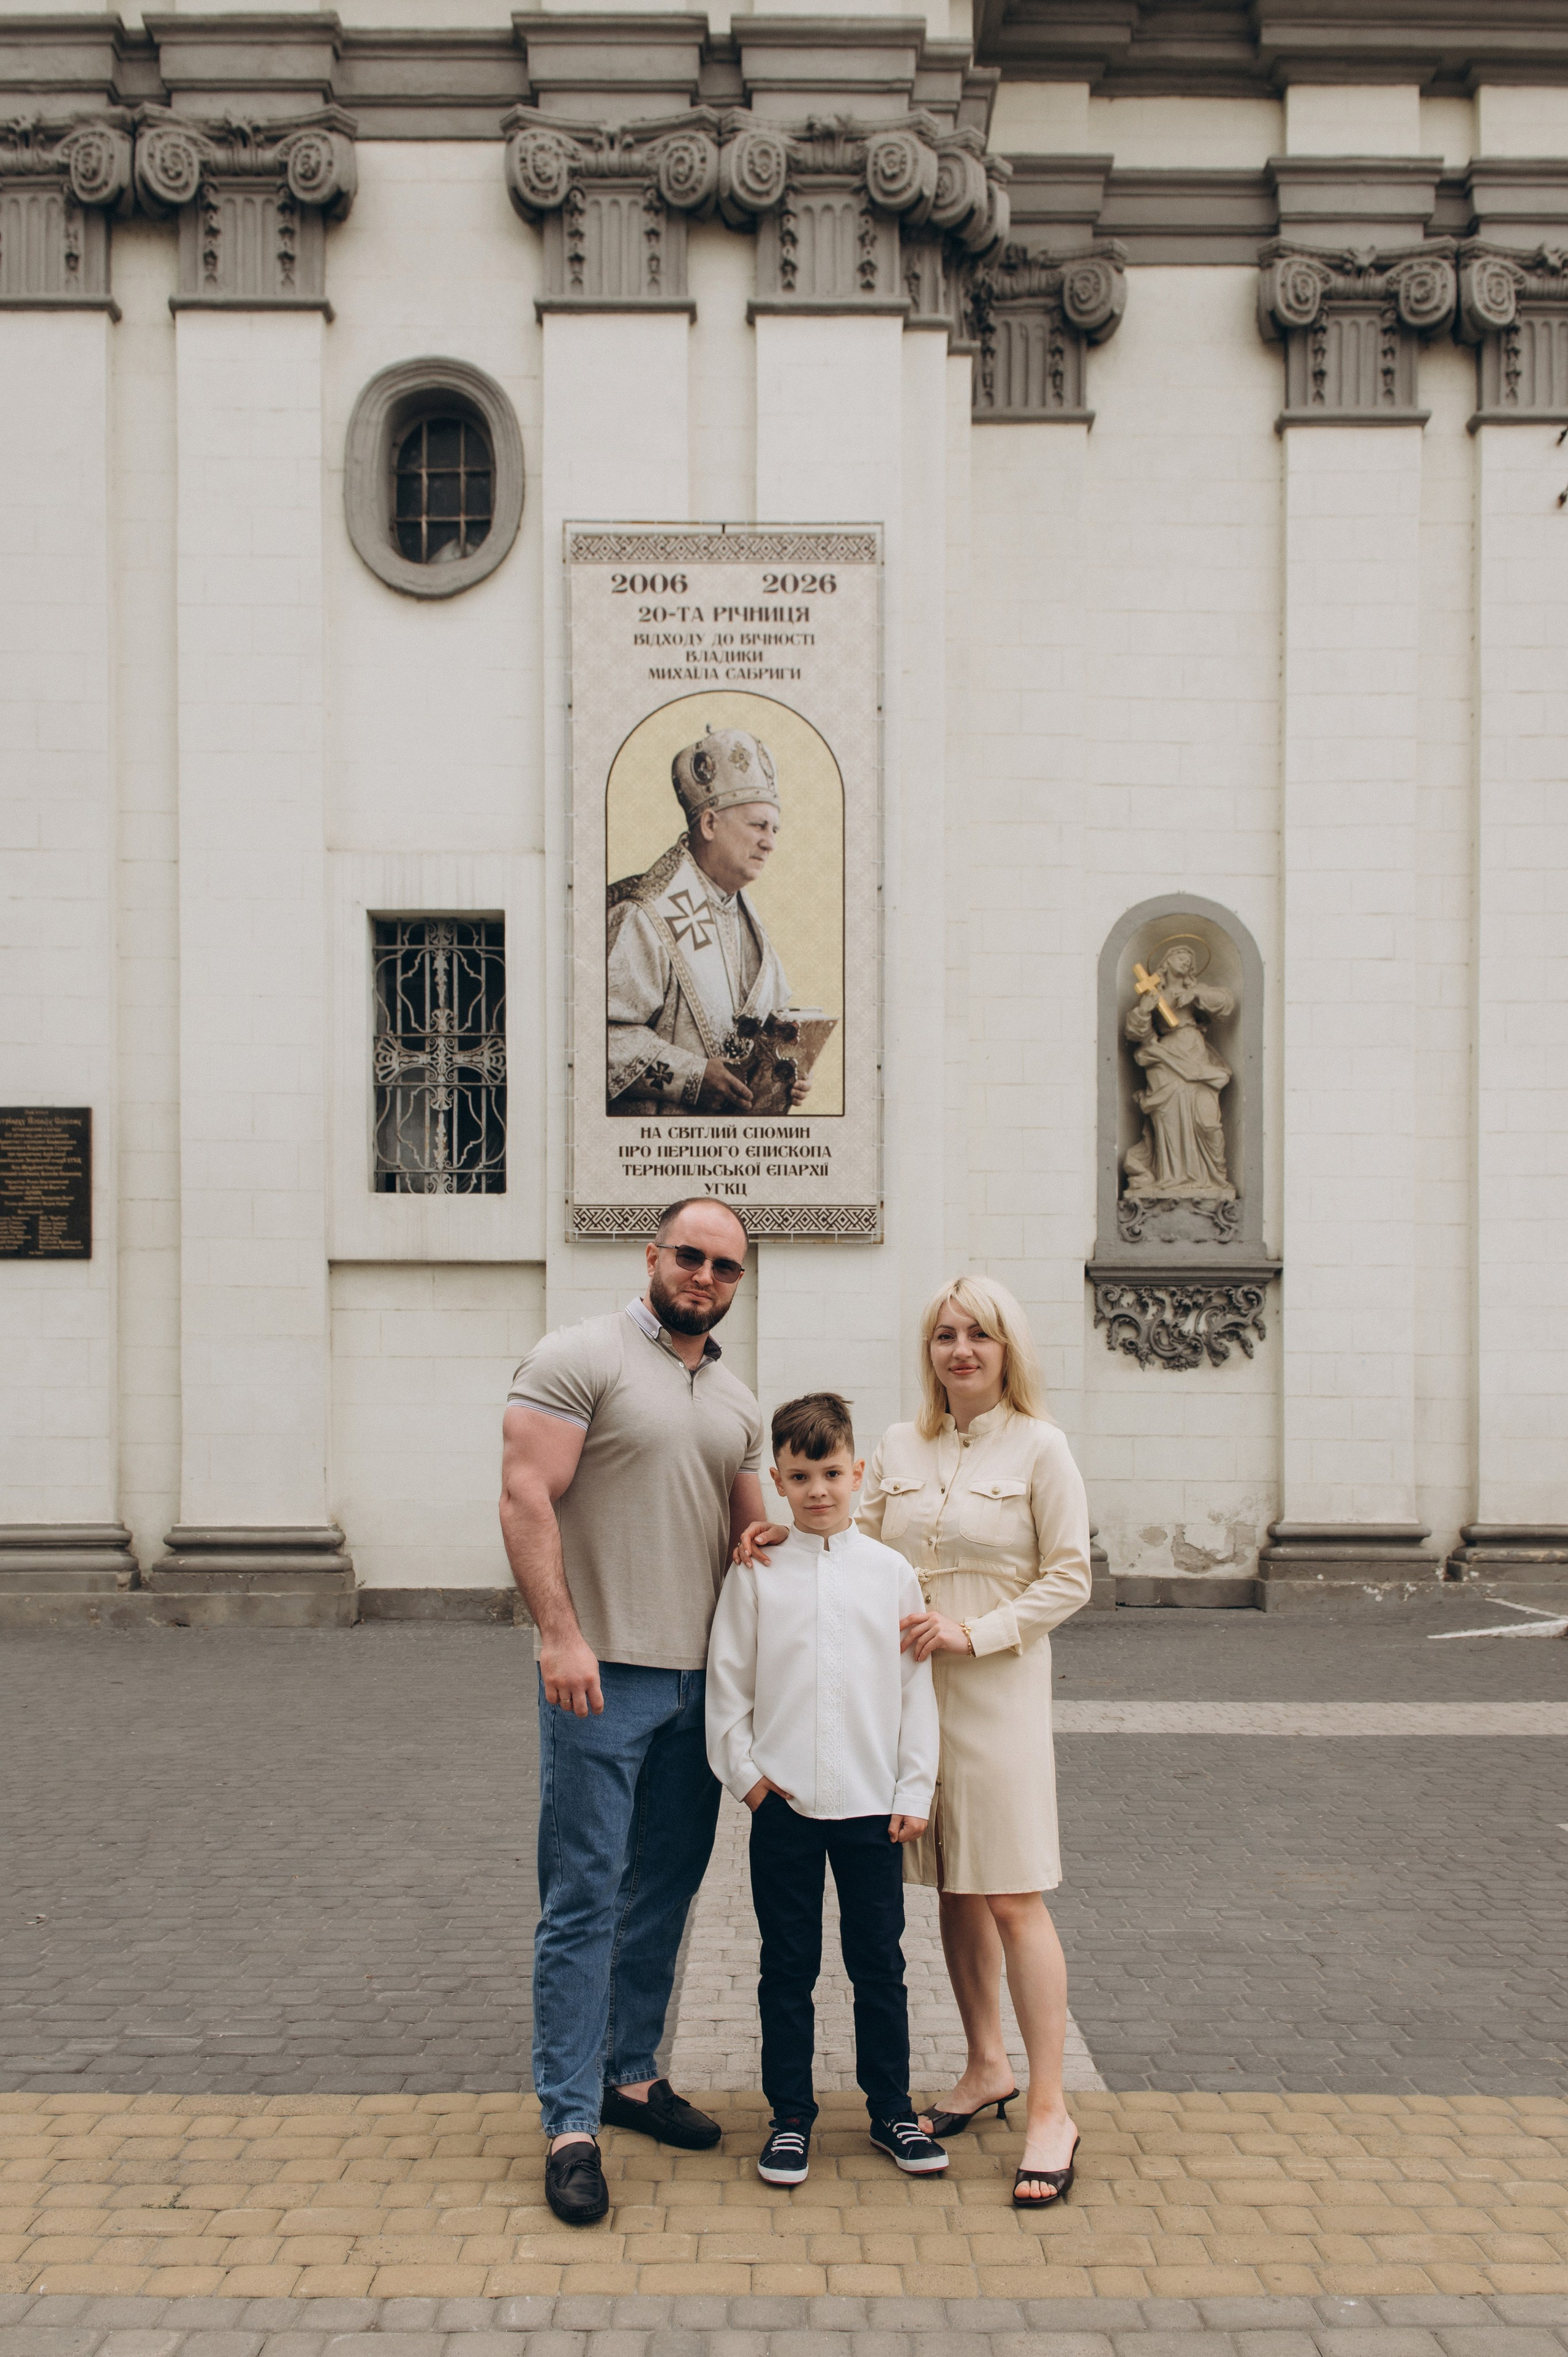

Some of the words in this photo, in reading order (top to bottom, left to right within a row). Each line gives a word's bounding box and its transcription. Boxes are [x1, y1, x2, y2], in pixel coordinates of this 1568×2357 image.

[611, 573, 688, 594] 2006
[763, 573, 837, 594] 2026
[638, 606, 704, 623] 20-ТА
[714, 606, 810, 624] РІЧНИЦЯ
[634, 633, 704, 647] ВІДХОДУ
[712, 633, 734, 647] ДО
[740, 633, 815, 646] ВІЧНОСТІ
[685, 650, 763, 663] ВЛАДИКИ
[648, 666, 719, 680] МИХАЇЛА
[725, 667, 801, 680] САБРИГИ
[641, 1127, 662, 1139] НА
[668, 1125, 737, 1139] СВІТЛИЙ
[742, 1127, 810, 1139] СПОМИН
[618, 1145, 652, 1158] ПРО
[657, 1145, 739, 1158] ПЕРШОГО
[745, 1145, 832, 1158] ЄПИСКОПА
[622, 1163, 761, 1177] ТЕРНОПІЛЬСЬКОЇ
[766, 1163, 829, 1177] ЄПАРХІЇ
[704, 1183, 748, 1197] УГКЦ
